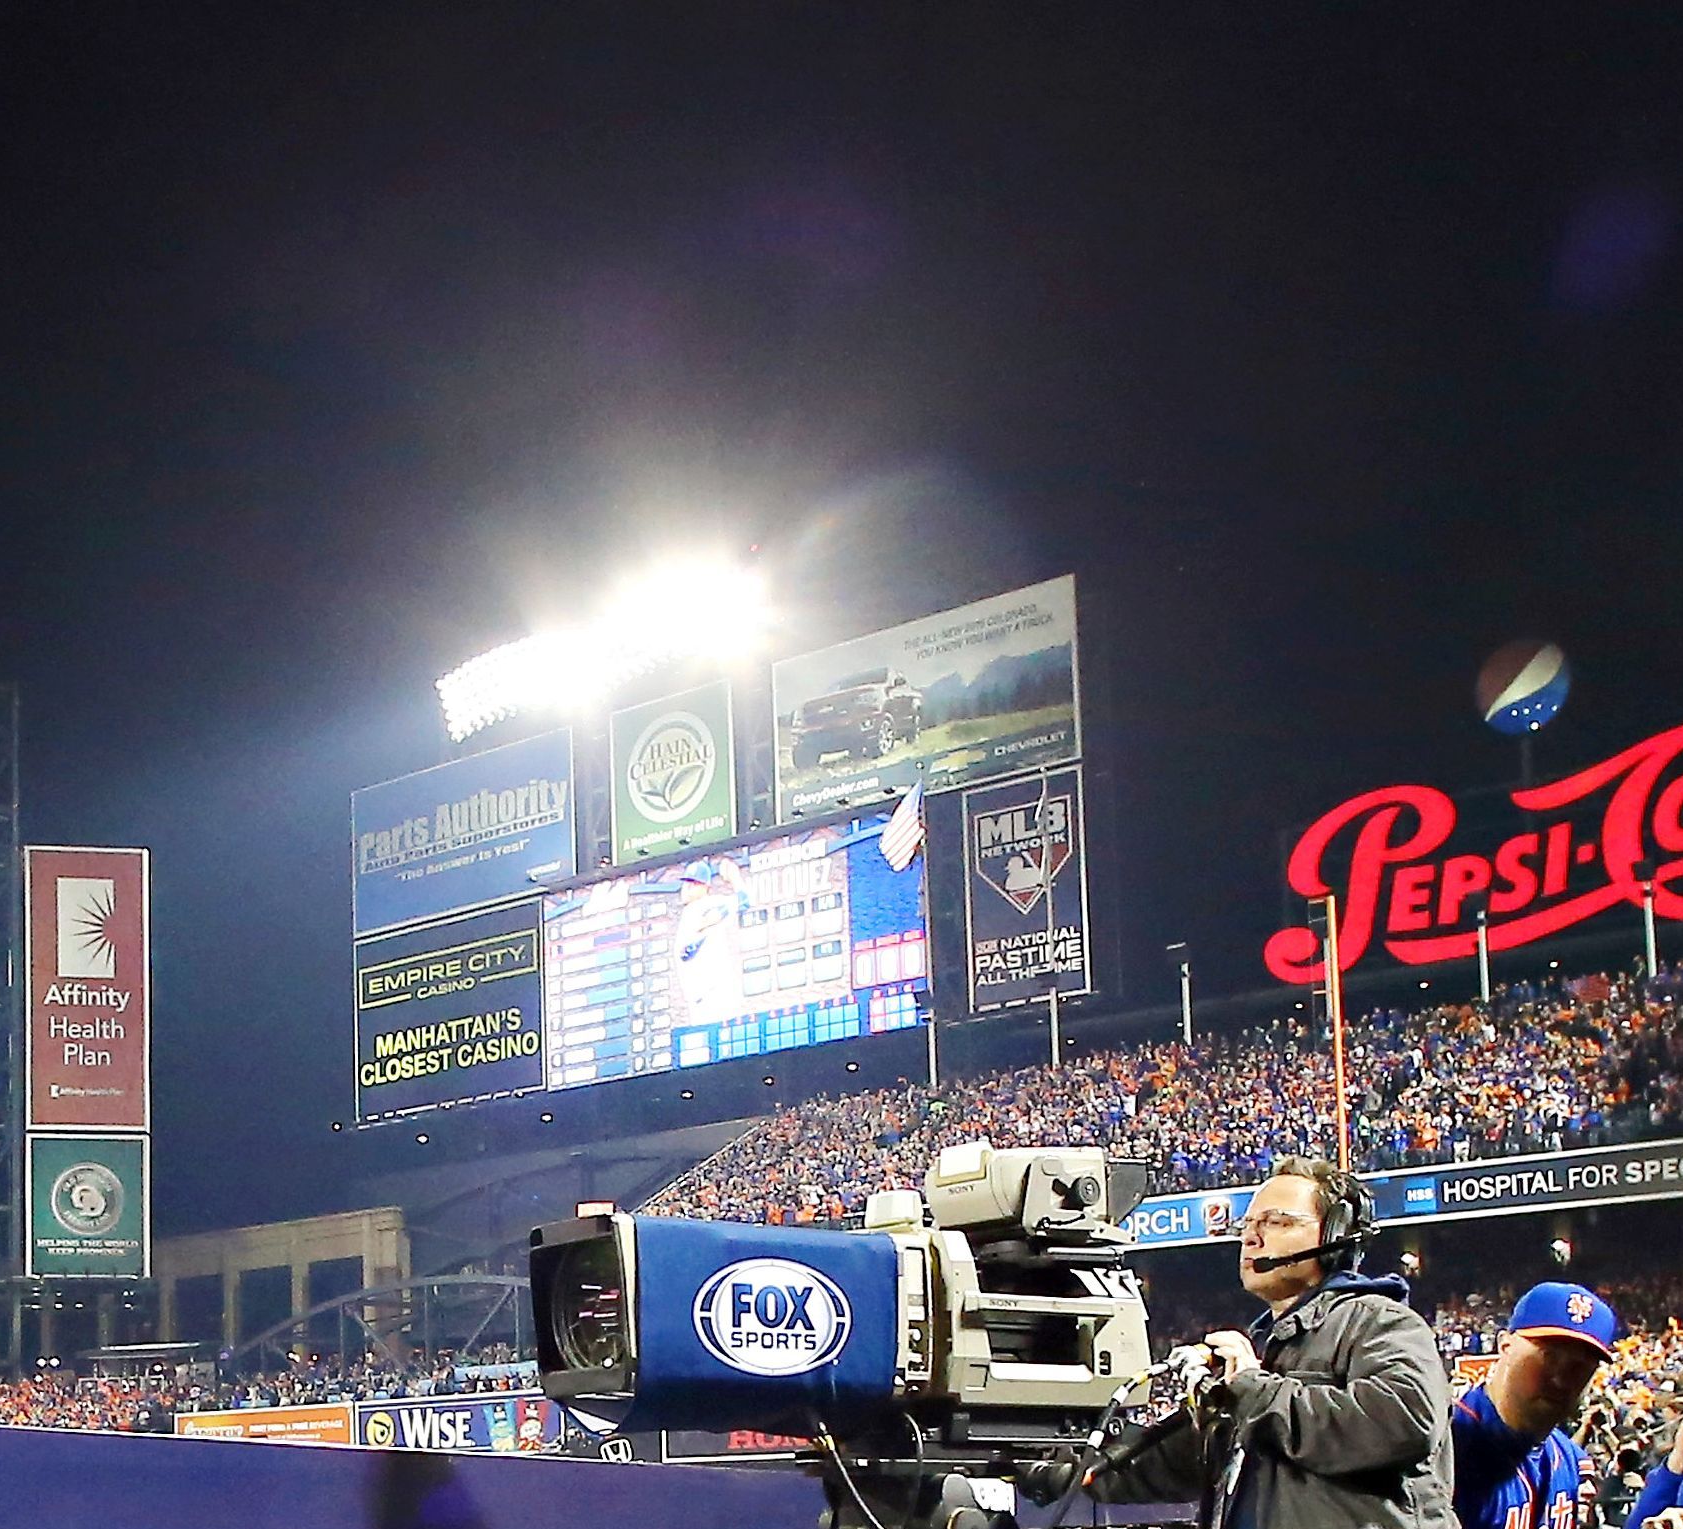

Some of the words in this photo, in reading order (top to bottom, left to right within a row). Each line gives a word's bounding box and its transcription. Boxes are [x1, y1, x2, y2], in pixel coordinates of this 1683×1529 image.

[650, 737, 692, 760] HAIN
[994, 730, 1067, 756] CHEVROLET
[630, 744, 714, 781] CELESTIAL
[359, 816, 430, 864] Parts
[434, 778, 568, 843] Authority
[980, 801, 1067, 849] MLB
[981, 833, 1067, 860] NETWOK
[976, 938, 1082, 975] PASTIME
[368, 960, 462, 995] EMPIRE
[417, 977, 476, 999] CASINO
[43, 984, 131, 1012] Affinity
[49, 1015, 125, 1039] Health
[375, 1007, 522, 1059] MANHATTAN'S
[63, 1042, 111, 1066] Plan
[360, 1047, 453, 1086] CLOSEST
[457, 1031, 540, 1068] CASINO
[947, 1183, 975, 1195] SONY
[1443, 1166, 1563, 1204] HOSPITAL
[1566, 1164, 1618, 1189] FOR
[729, 1282, 816, 1332] FOX
[988, 1299, 1019, 1308] SONY
[729, 1331, 817, 1351] SPORTS
